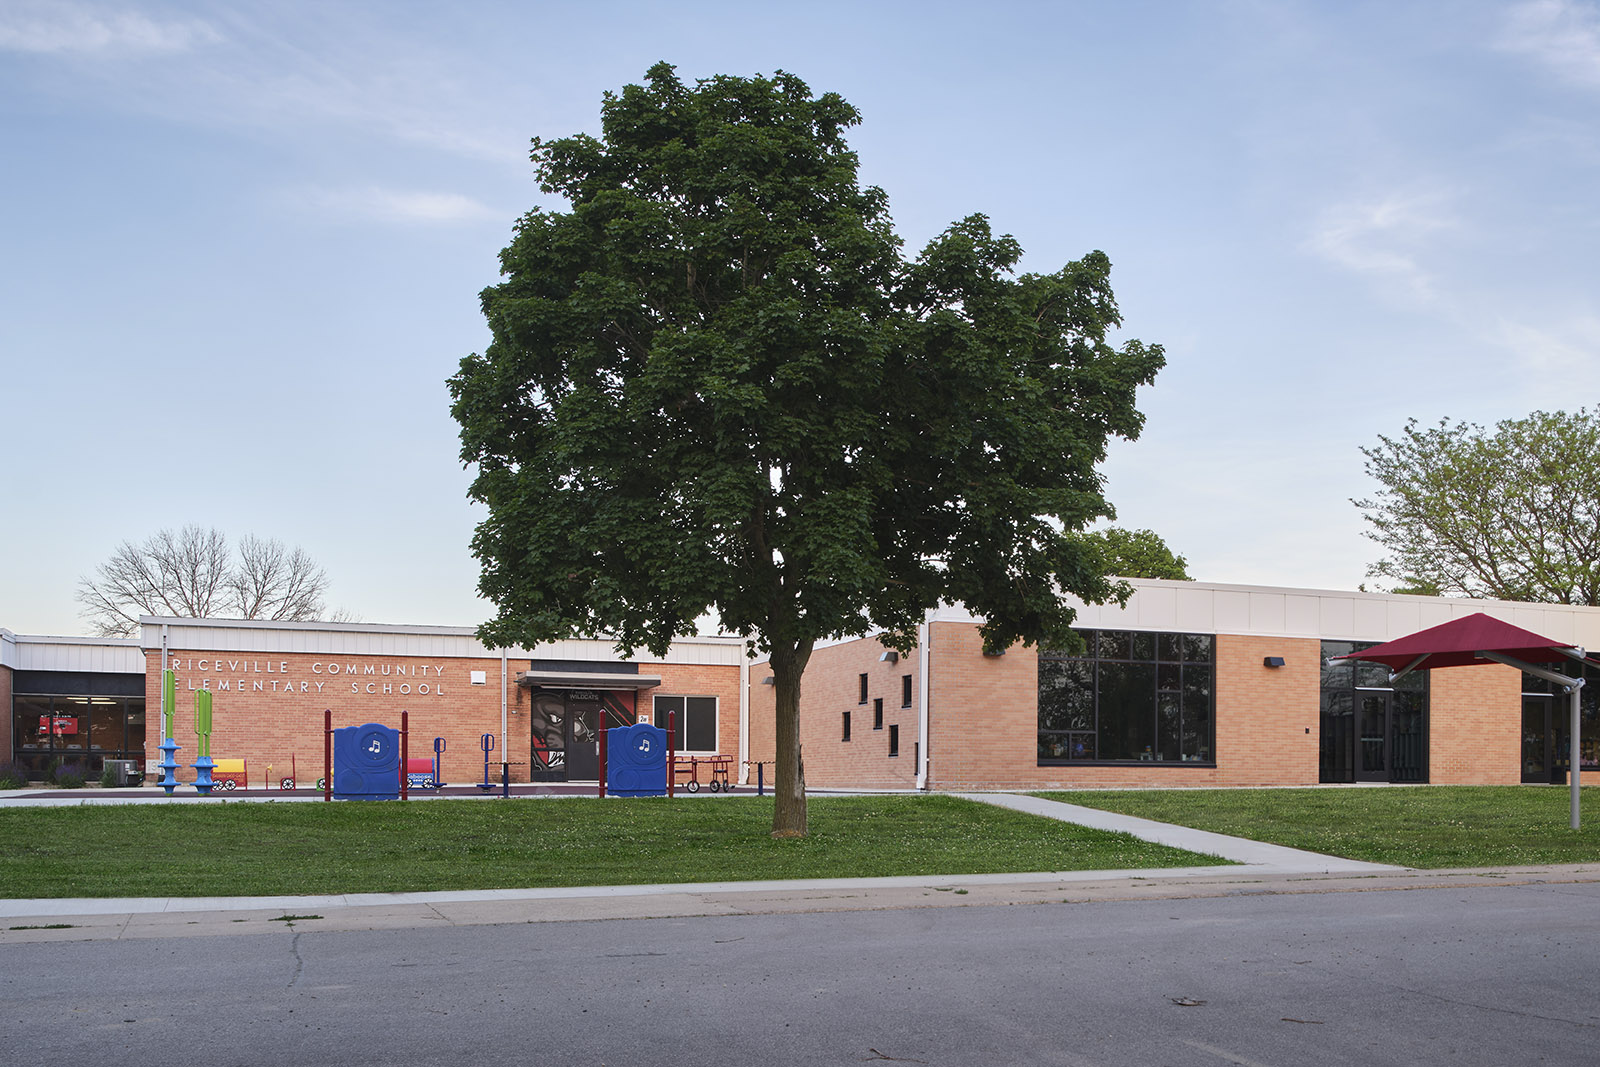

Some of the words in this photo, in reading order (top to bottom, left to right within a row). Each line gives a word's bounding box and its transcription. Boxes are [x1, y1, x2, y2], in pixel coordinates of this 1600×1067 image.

[172, 659, 288, 674] RICEVILLE
[312, 662, 445, 677] COMMUNITY
[351, 682, 445, 696] SCHOOL
